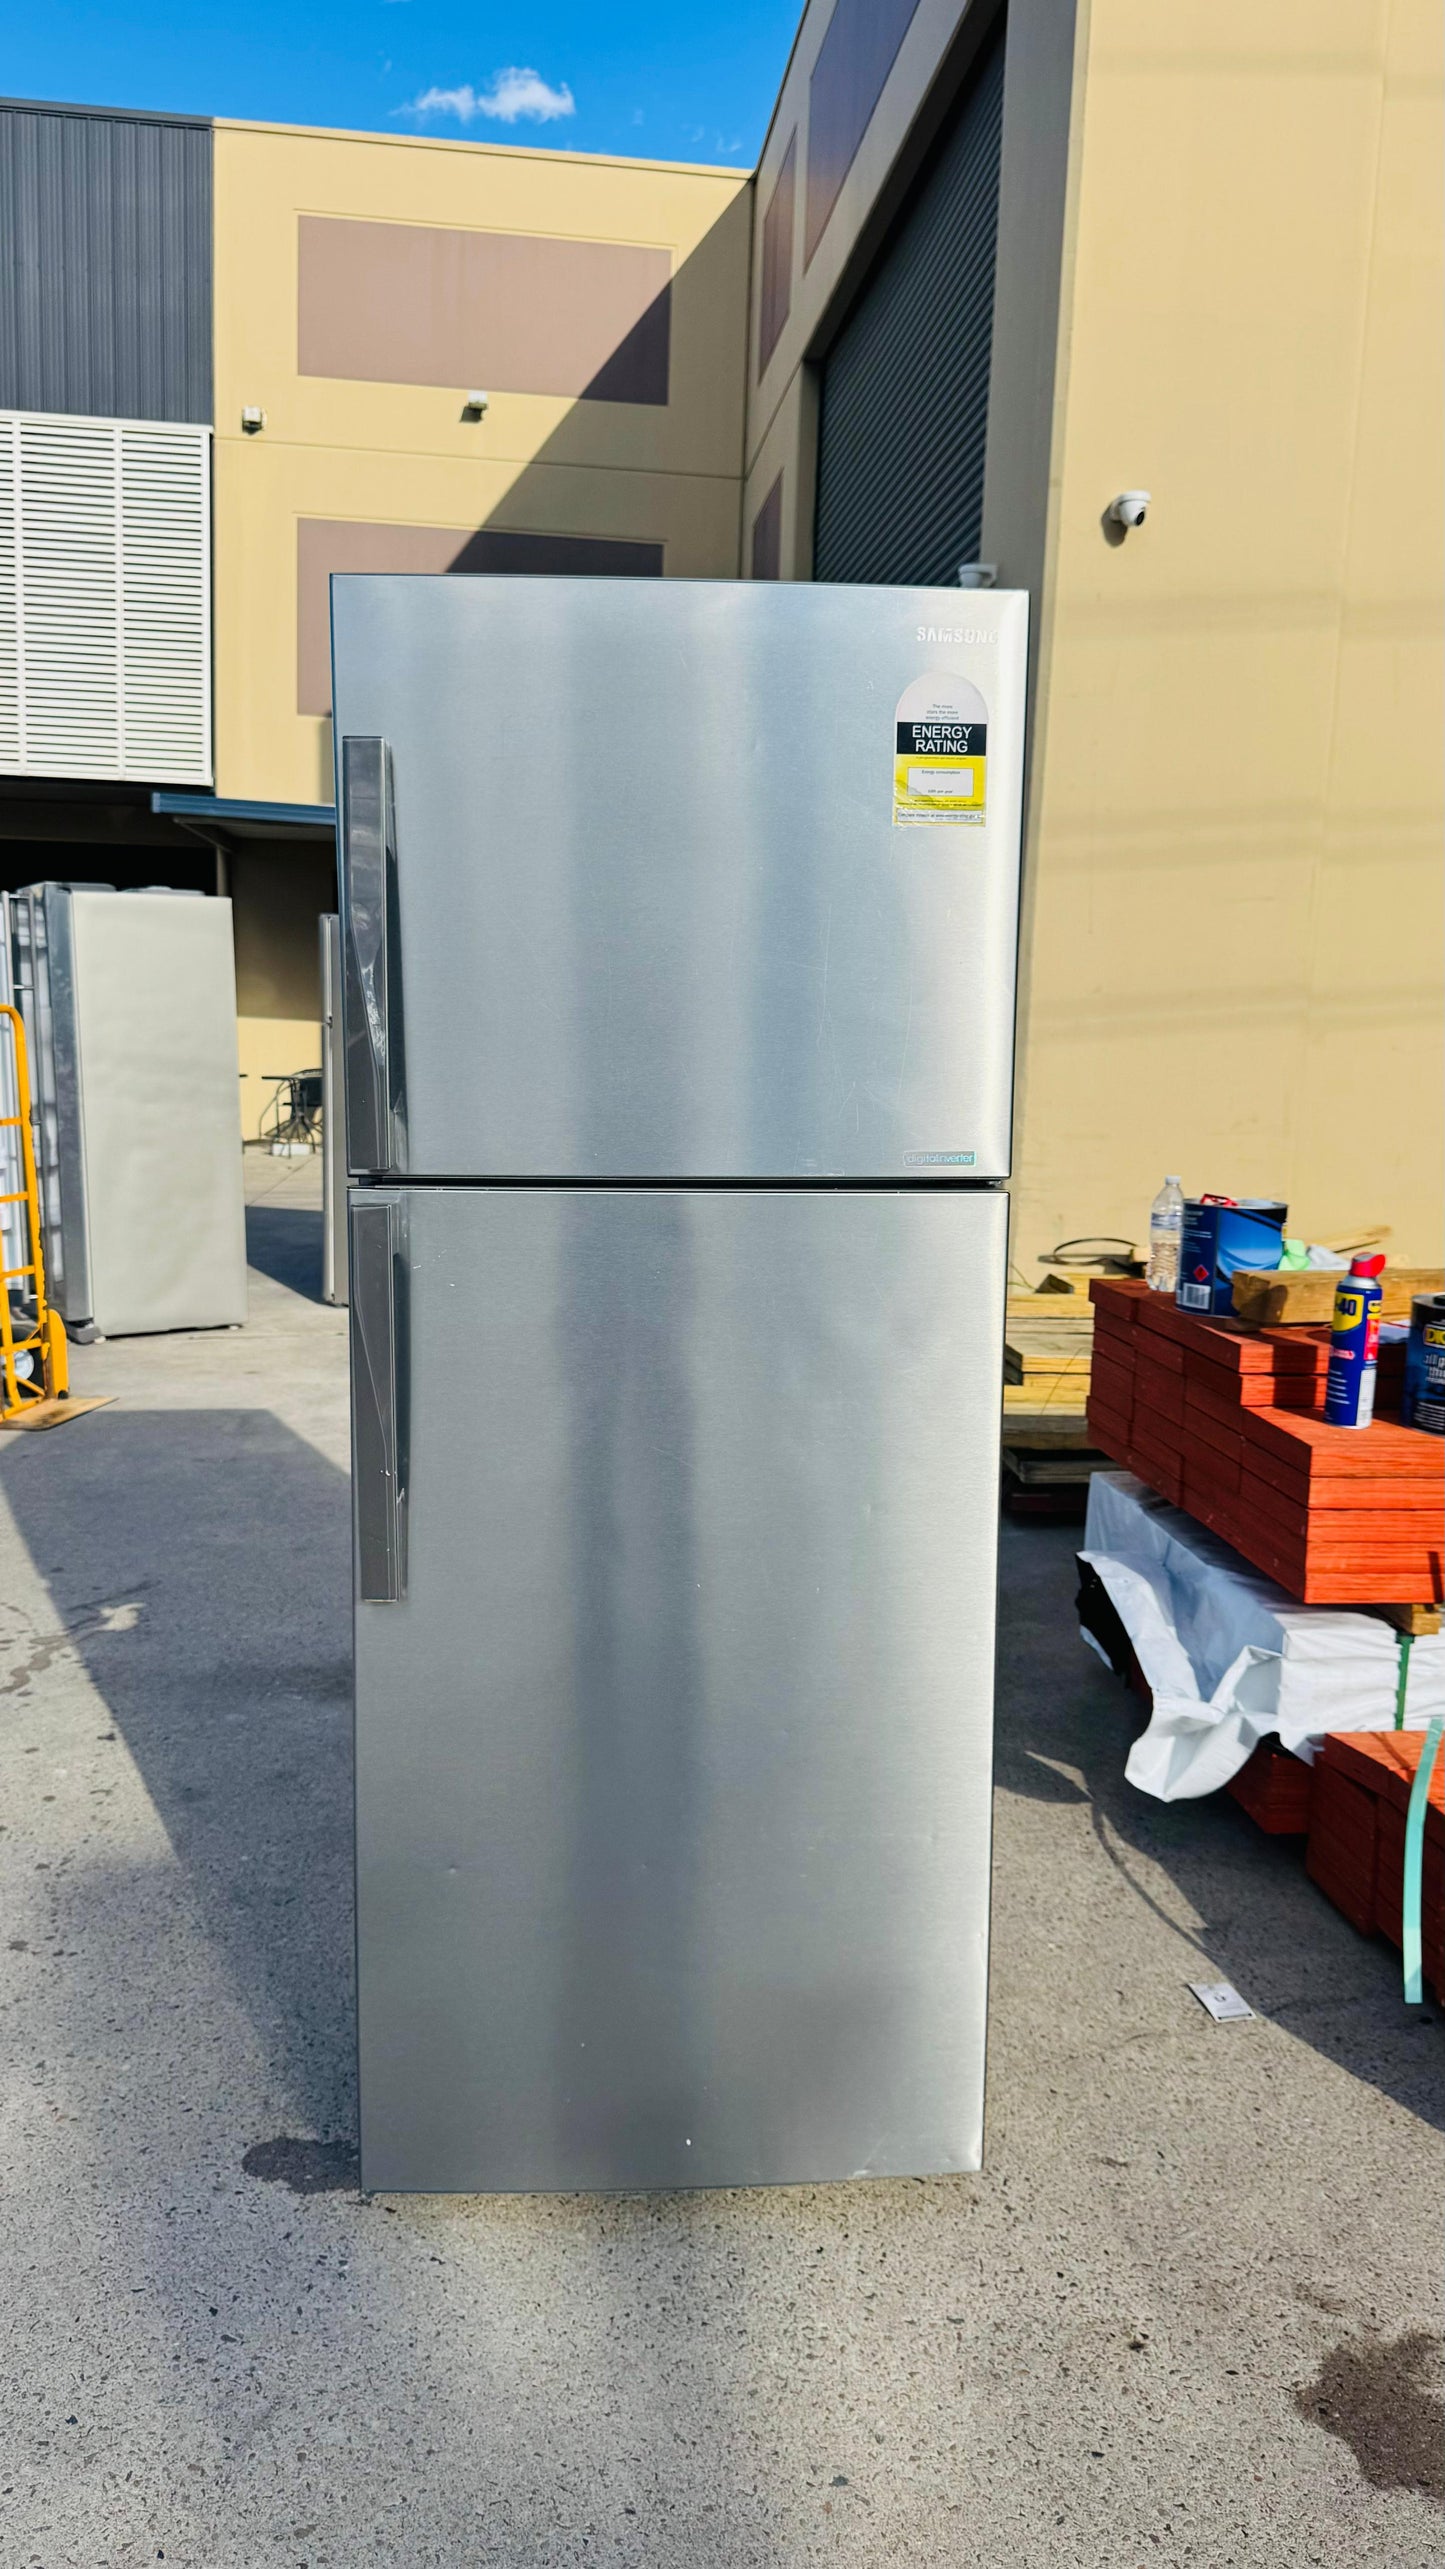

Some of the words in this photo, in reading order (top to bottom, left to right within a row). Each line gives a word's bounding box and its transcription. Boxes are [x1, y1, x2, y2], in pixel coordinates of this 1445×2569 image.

[916, 626, 999, 645] SAMSUNG
[912, 725, 973, 739] ENERGY
[915, 739, 968, 753] RATING
